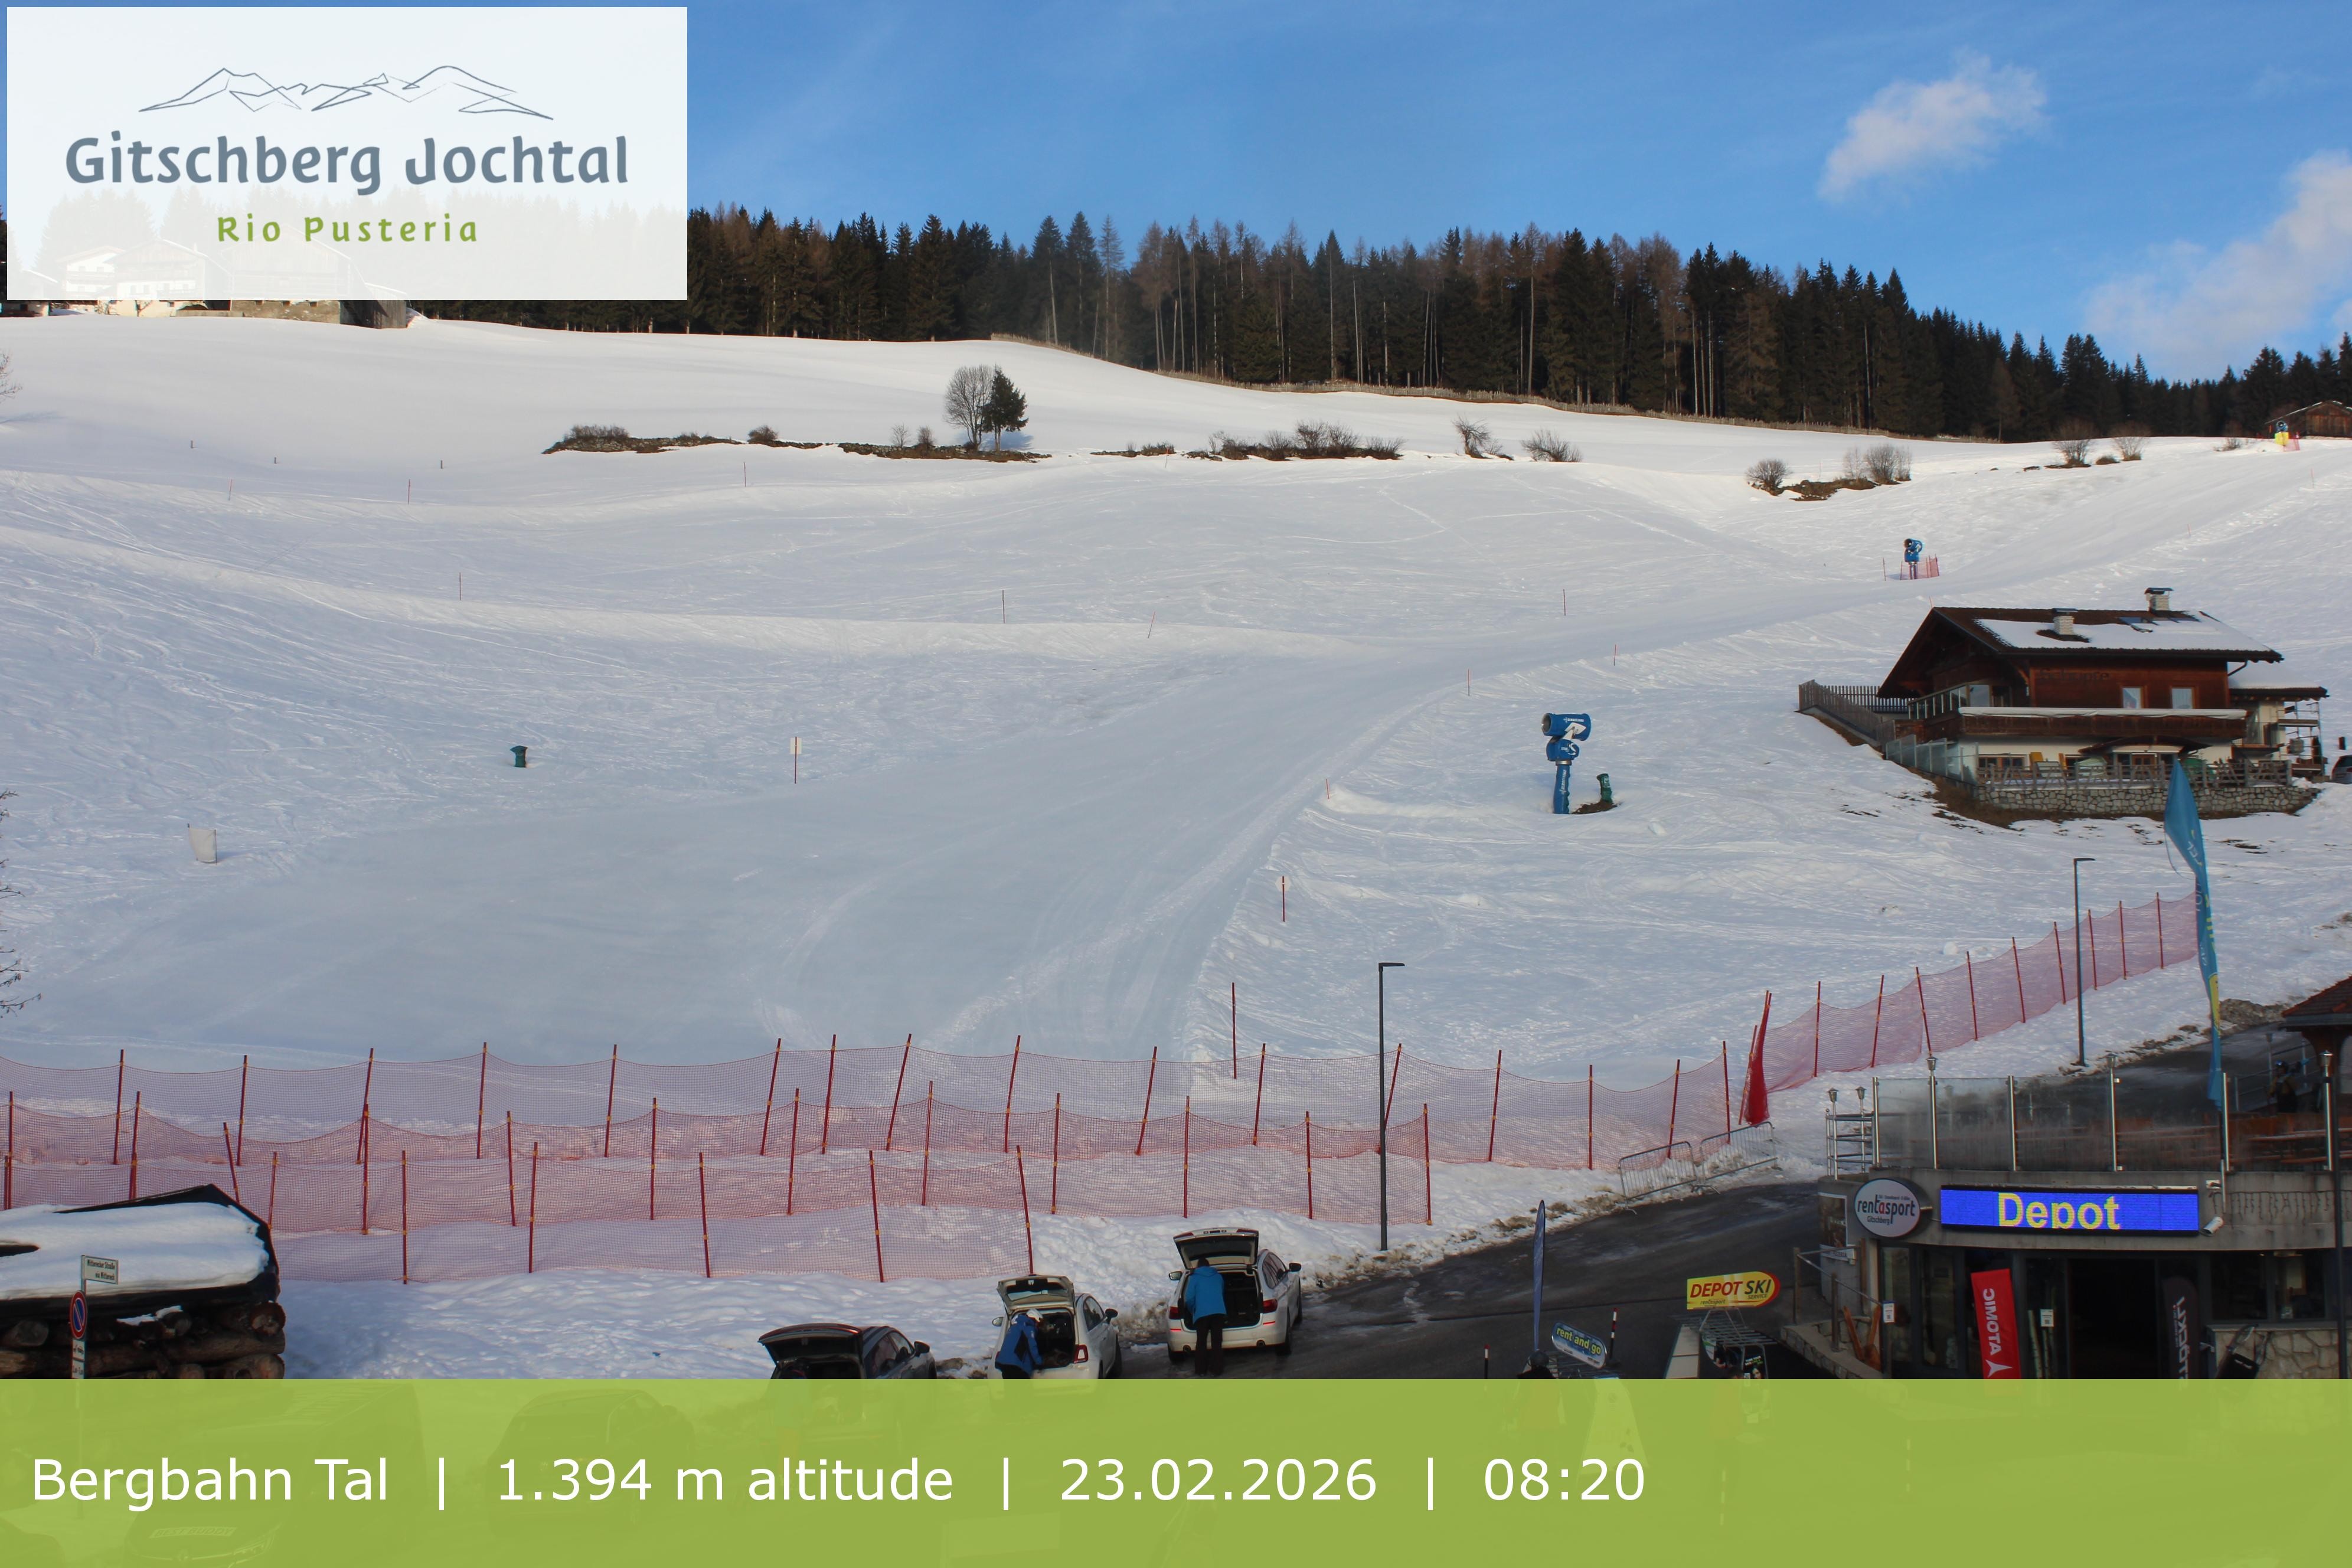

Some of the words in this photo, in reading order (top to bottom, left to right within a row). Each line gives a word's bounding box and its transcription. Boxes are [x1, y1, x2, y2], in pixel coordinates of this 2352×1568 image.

[1857, 1194, 1916, 1224] rentasport
[1998, 1192, 2121, 1230] Depot
[1690, 1280, 1743, 1298] DEPOT
[1745, 1279, 1772, 1295] SKI
[1556, 1327, 1573, 1341] rent
[1574, 1335, 1590, 1350] and
[1591, 1344, 1602, 1355] go
